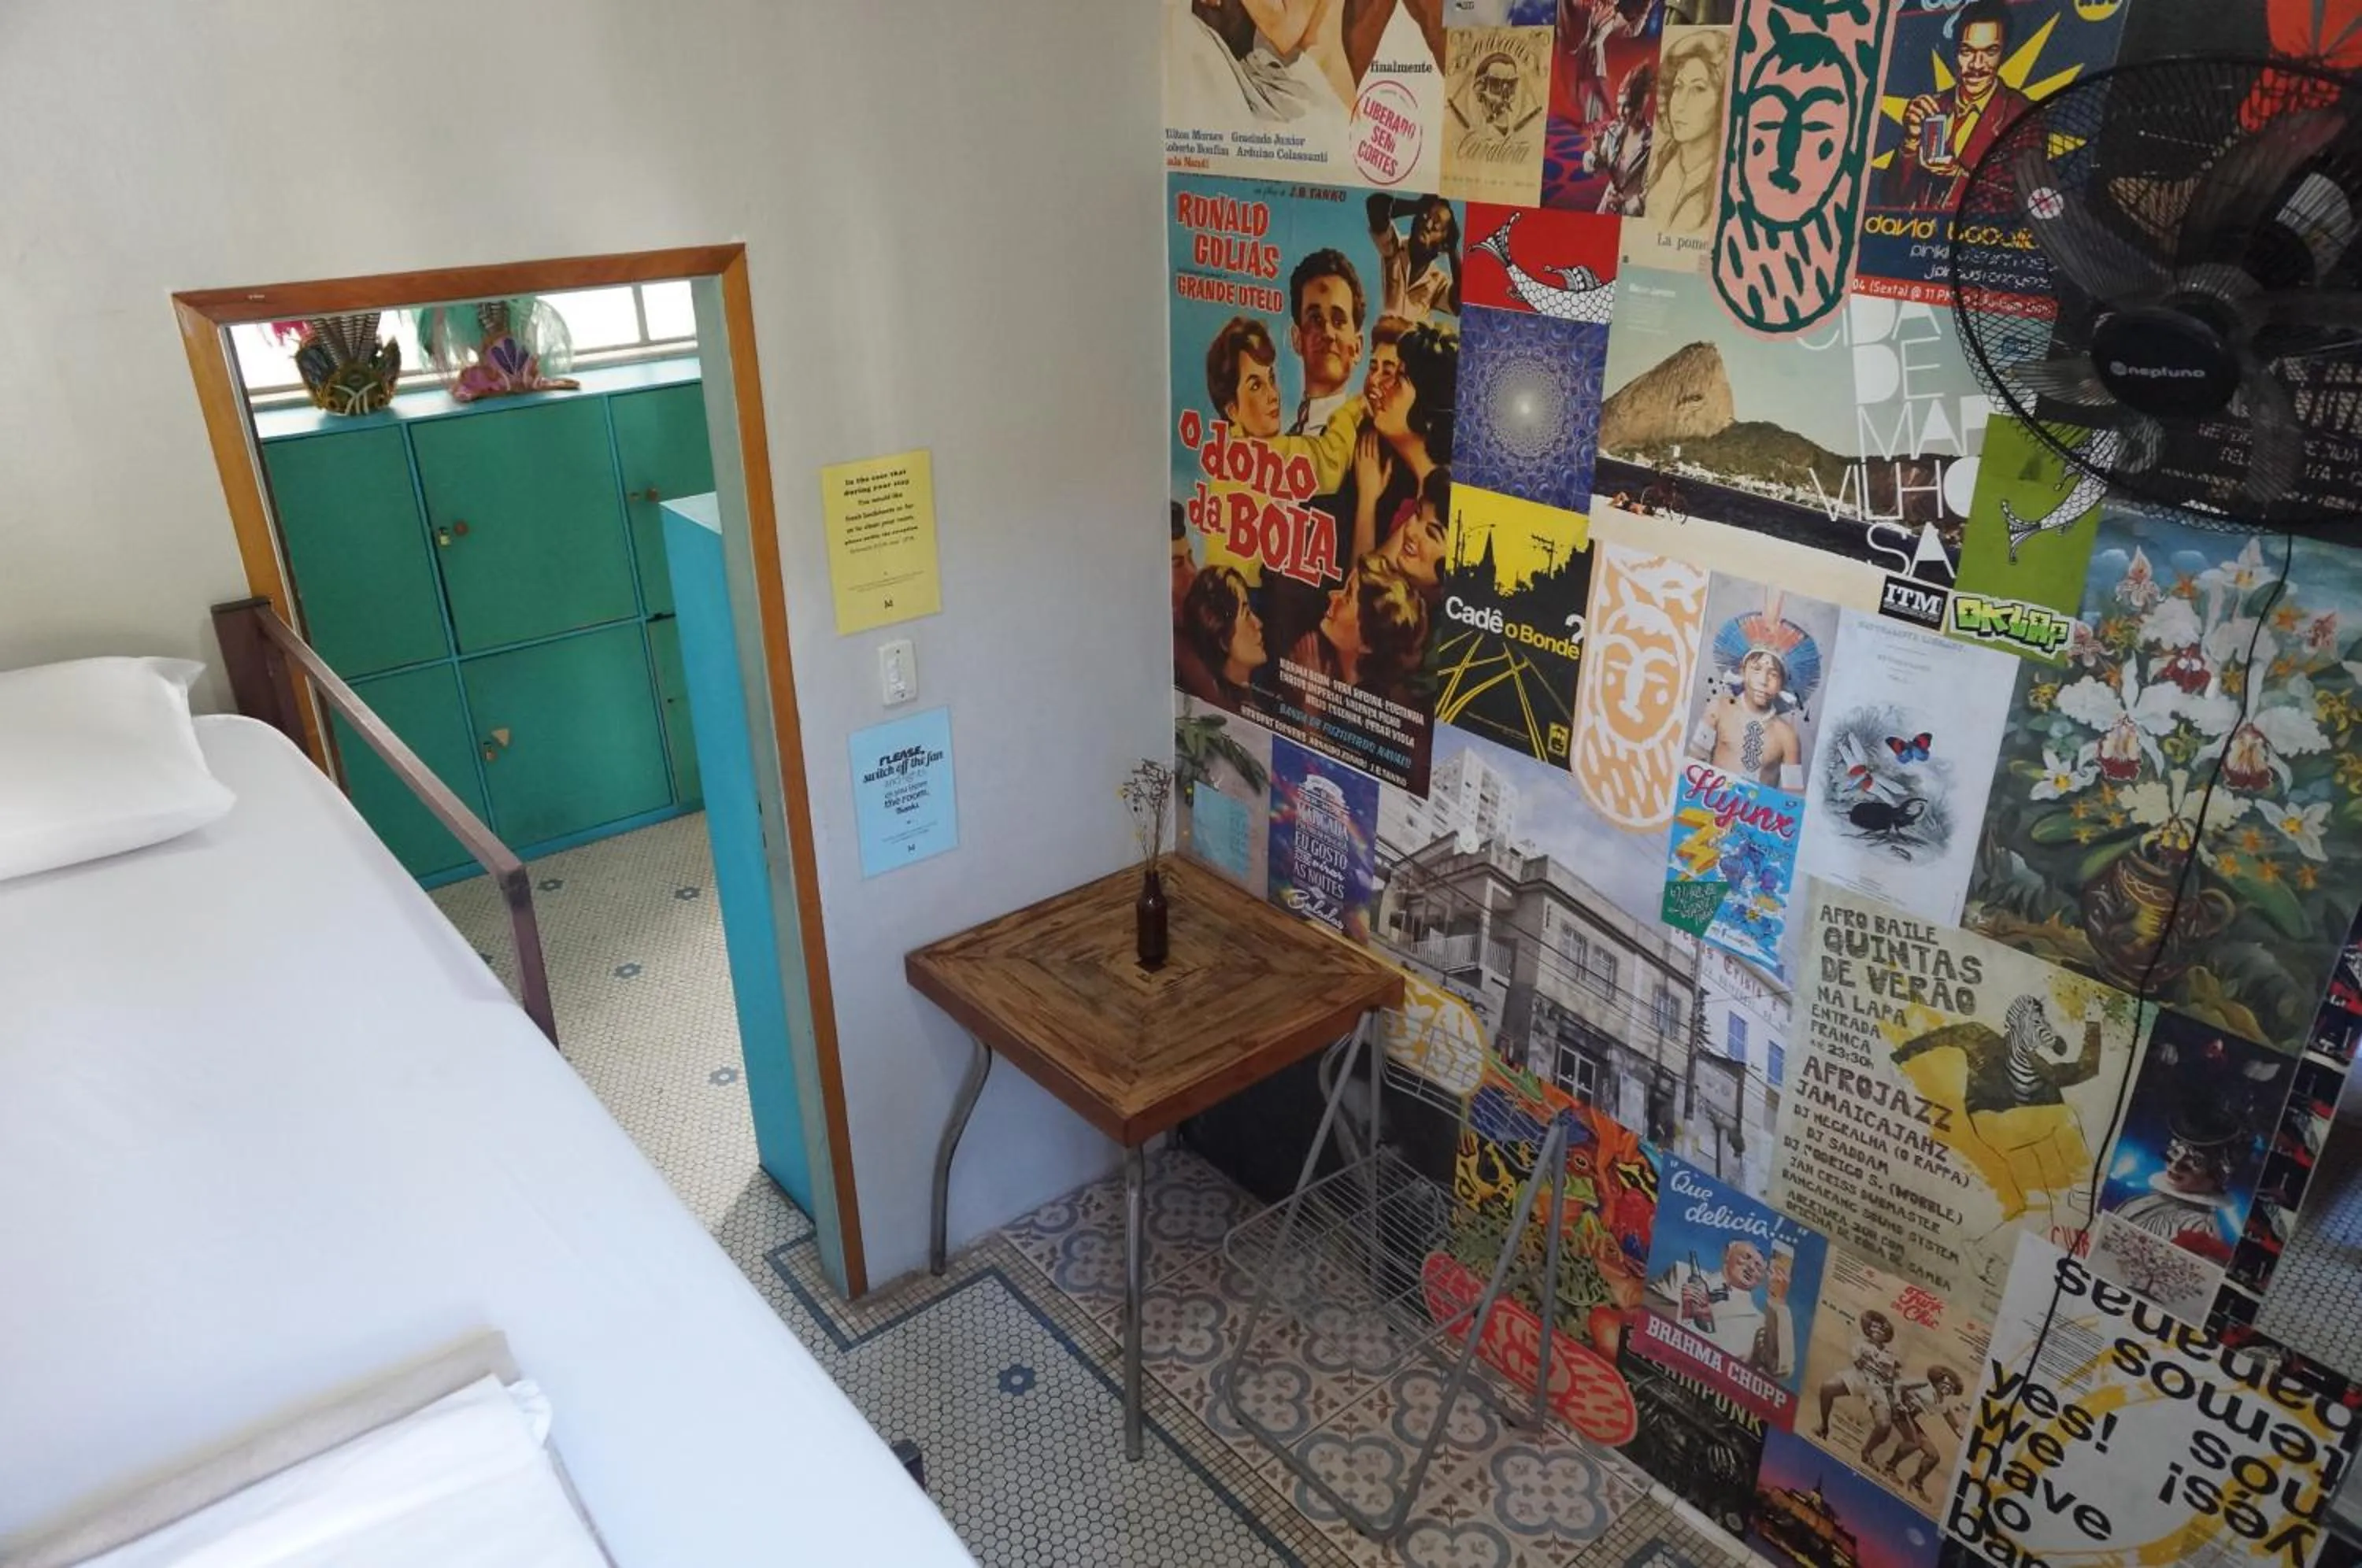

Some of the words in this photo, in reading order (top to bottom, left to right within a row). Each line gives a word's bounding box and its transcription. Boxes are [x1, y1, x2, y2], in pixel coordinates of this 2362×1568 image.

[1370, 60, 1433, 73] finalmente
[1363, 96, 1416, 139] LIBERADO
[1371, 125, 1396, 153] SEM
[1357, 140, 1398, 177] CORTES
[1176, 191, 1270, 238] RONALD
[1194, 233, 1281, 280] GOLIAS
[1177, 274, 1236, 305] GRANDE
[1238, 284, 1284, 313] OTELO
[1200, 419, 1319, 502] dono
[1187, 480, 1226, 535] da
[1226, 491, 1342, 587] BOLA
[1867, 521, 1957, 579] SA
[1445, 595, 1504, 634] Cadê
[1505, 622, 1519, 638] o
[1520, 624, 1581, 660] Bonde
[862, 764, 894, 784] switch
[895, 757, 909, 776] off
[924, 749, 944, 767] fan
[1310, 838, 1348, 871] GOSTO
[1820, 904, 1868, 930] AFRO
[1874, 915, 1939, 947] BAILE
[1821, 955, 1857, 989] DE
[1865, 964, 1977, 1016] VERÃO
[1823, 926, 1983, 986] QUINTAS
[1816, 985, 1846, 1009] NA
[1853, 994, 1908, 1028] LAPA
[1802, 1055, 1953, 1133] AFROJAZZ
[1646, 1314, 1723, 1374] BRAHMA
[1727, 1361, 1788, 1409] CHOPP
[2055, 1256, 2360, 1455] bananas
[1979, 1396, 2066, 1469] we
[1985, 1359, 2119, 1455] yes!
[2112, 1337, 2346, 1492] temos
[1956, 1469, 2032, 1533] no
[1965, 1424, 2112, 1541] have
